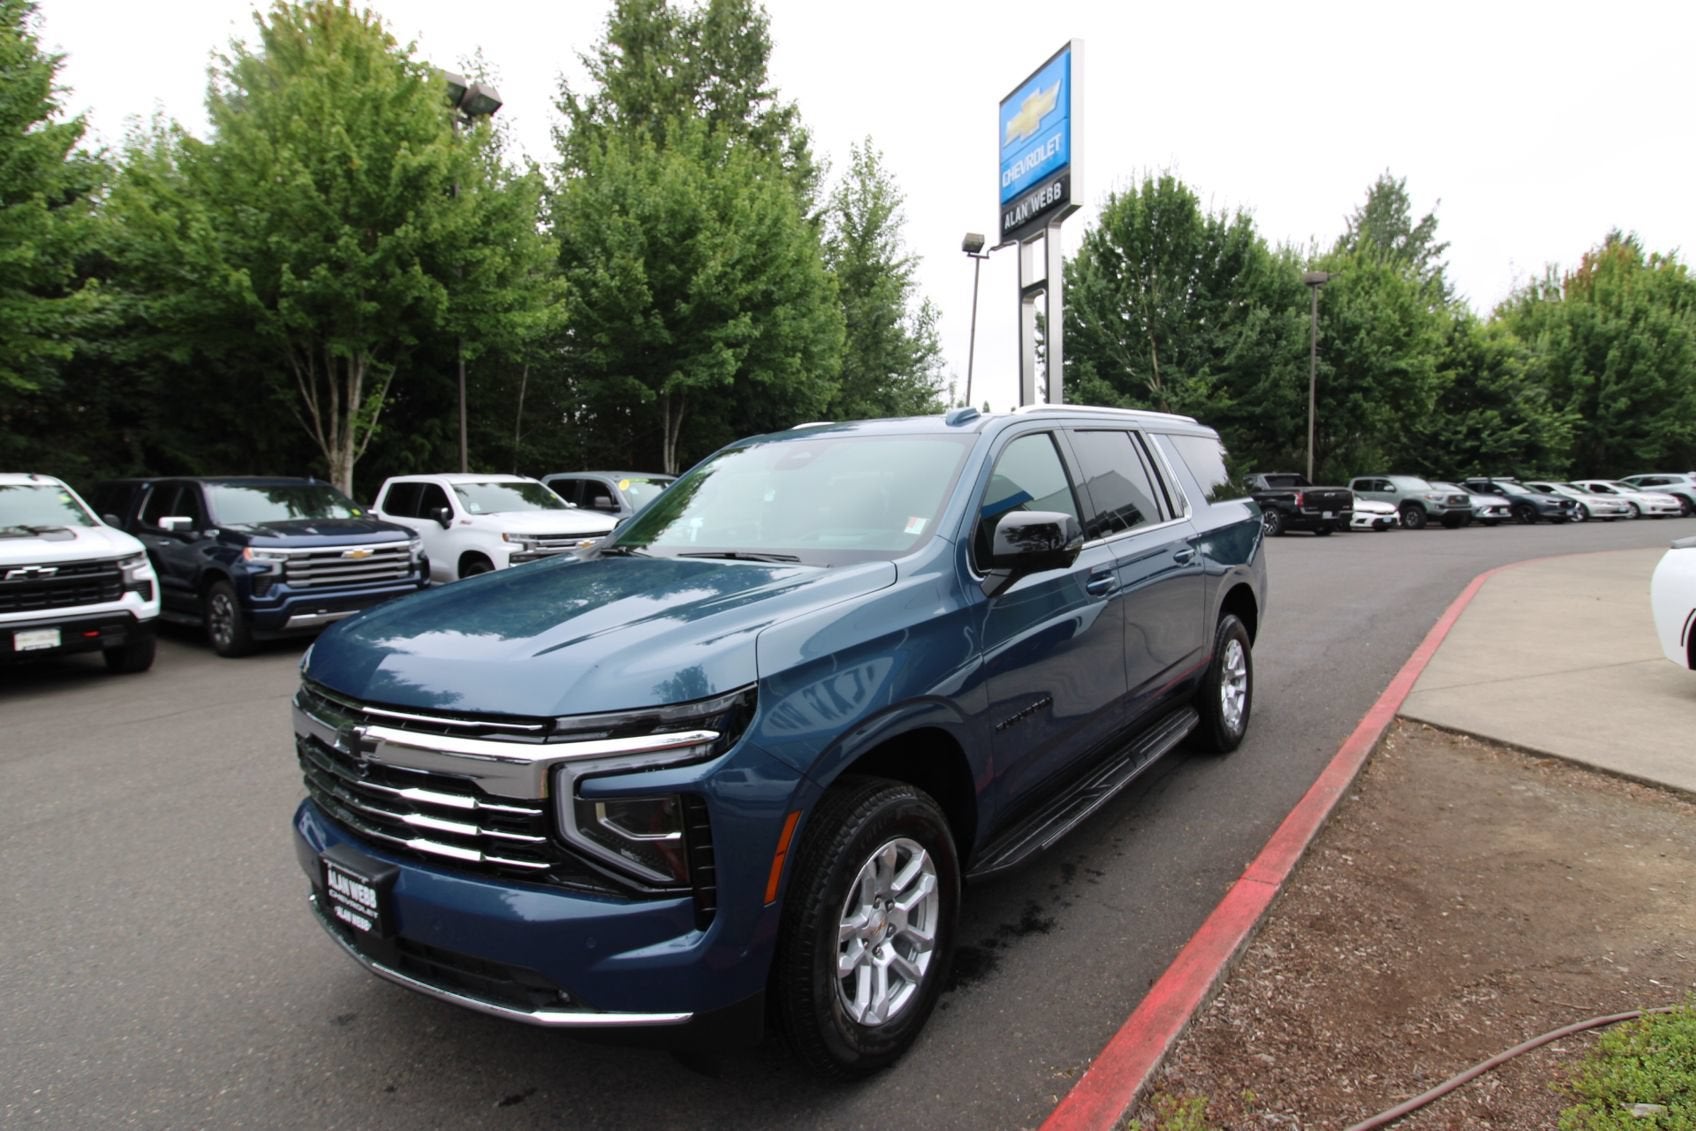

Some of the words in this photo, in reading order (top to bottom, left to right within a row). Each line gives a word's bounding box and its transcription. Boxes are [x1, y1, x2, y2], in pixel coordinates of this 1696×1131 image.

[1002, 133, 1062, 188] CHEVROLET
[1004, 202, 1028, 230] ALAN
[1031, 182, 1062, 213] WEBB
